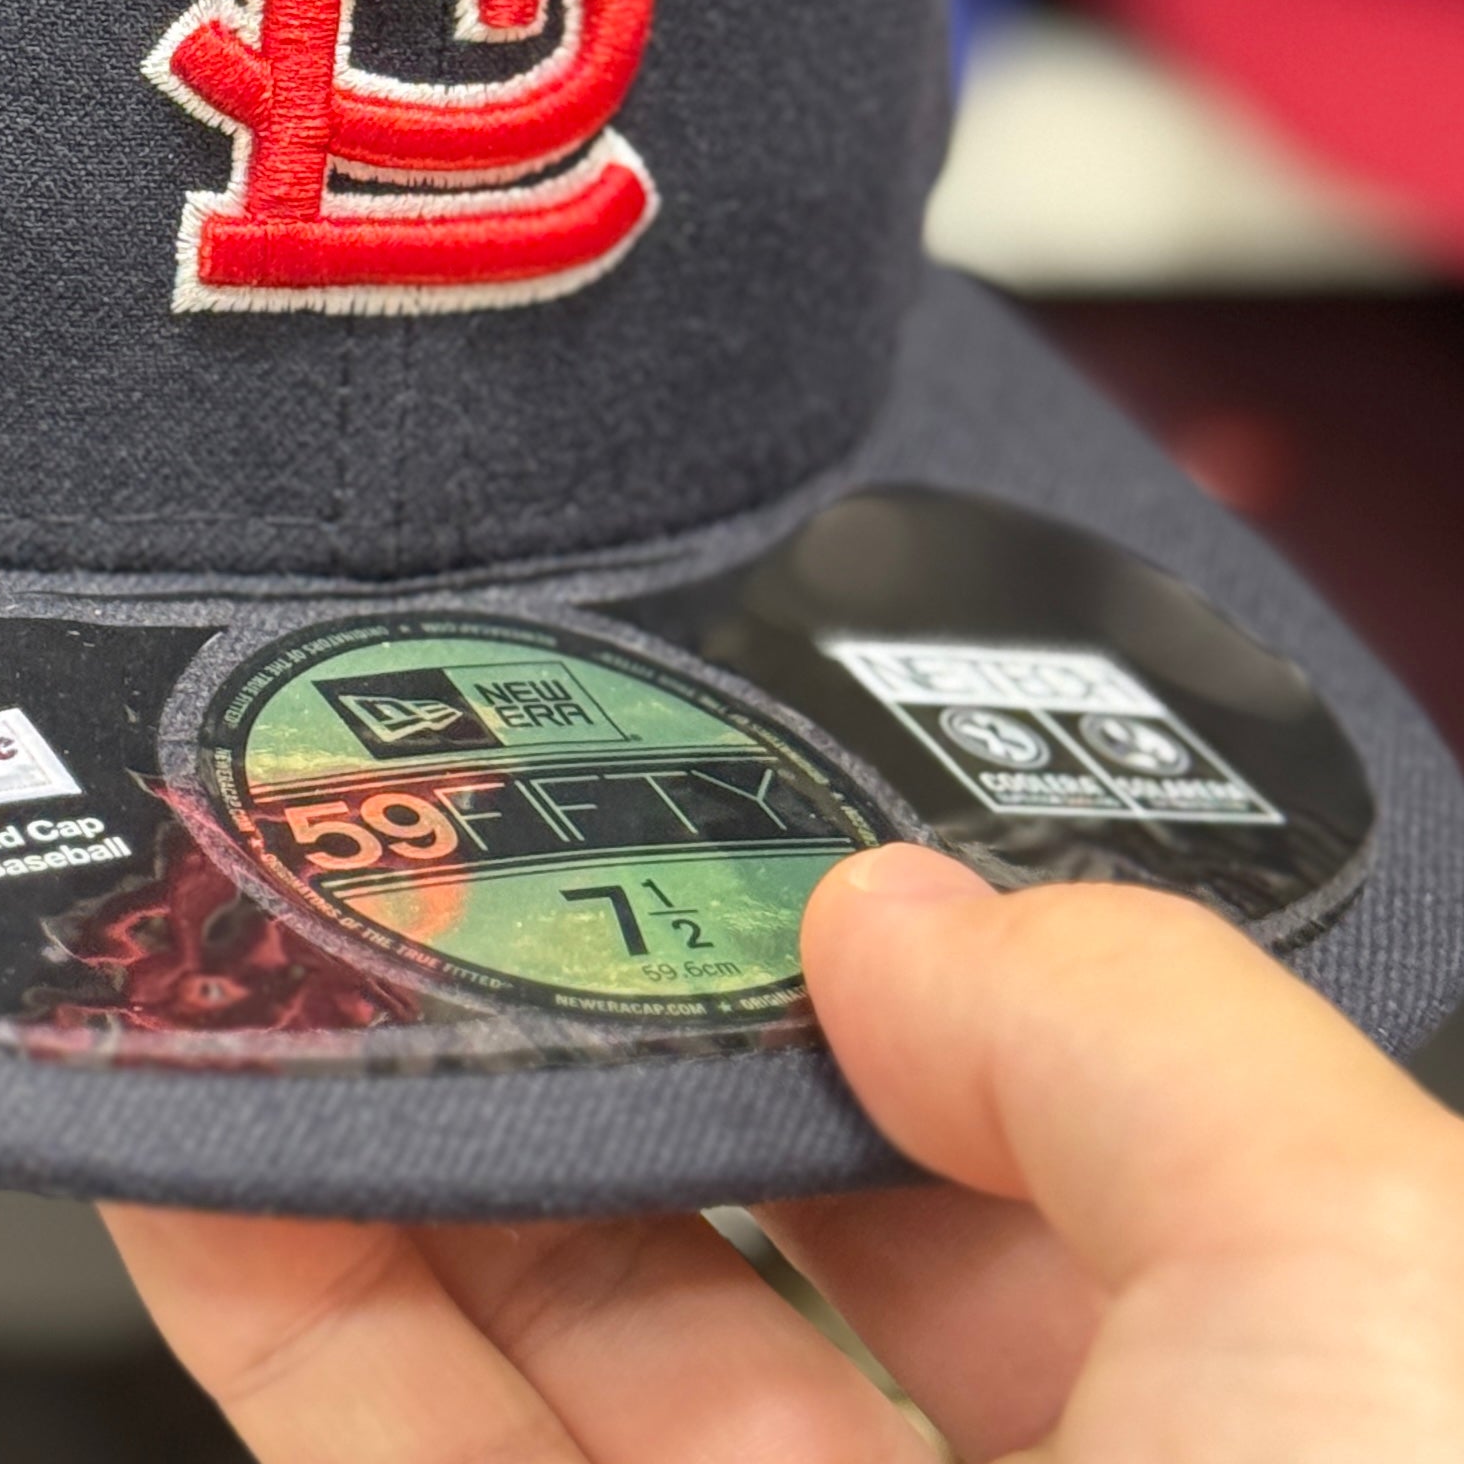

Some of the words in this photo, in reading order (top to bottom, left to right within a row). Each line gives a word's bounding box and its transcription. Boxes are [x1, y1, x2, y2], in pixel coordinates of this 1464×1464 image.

[472, 679, 573, 706] NEW
[493, 702, 595, 728] ERA
[26, 817, 105, 842] Cap
[559, 885, 650, 957] 7
[395, 944, 441, 969] TRUE
[554, 993, 707, 1016] NEWERACAP.COM
